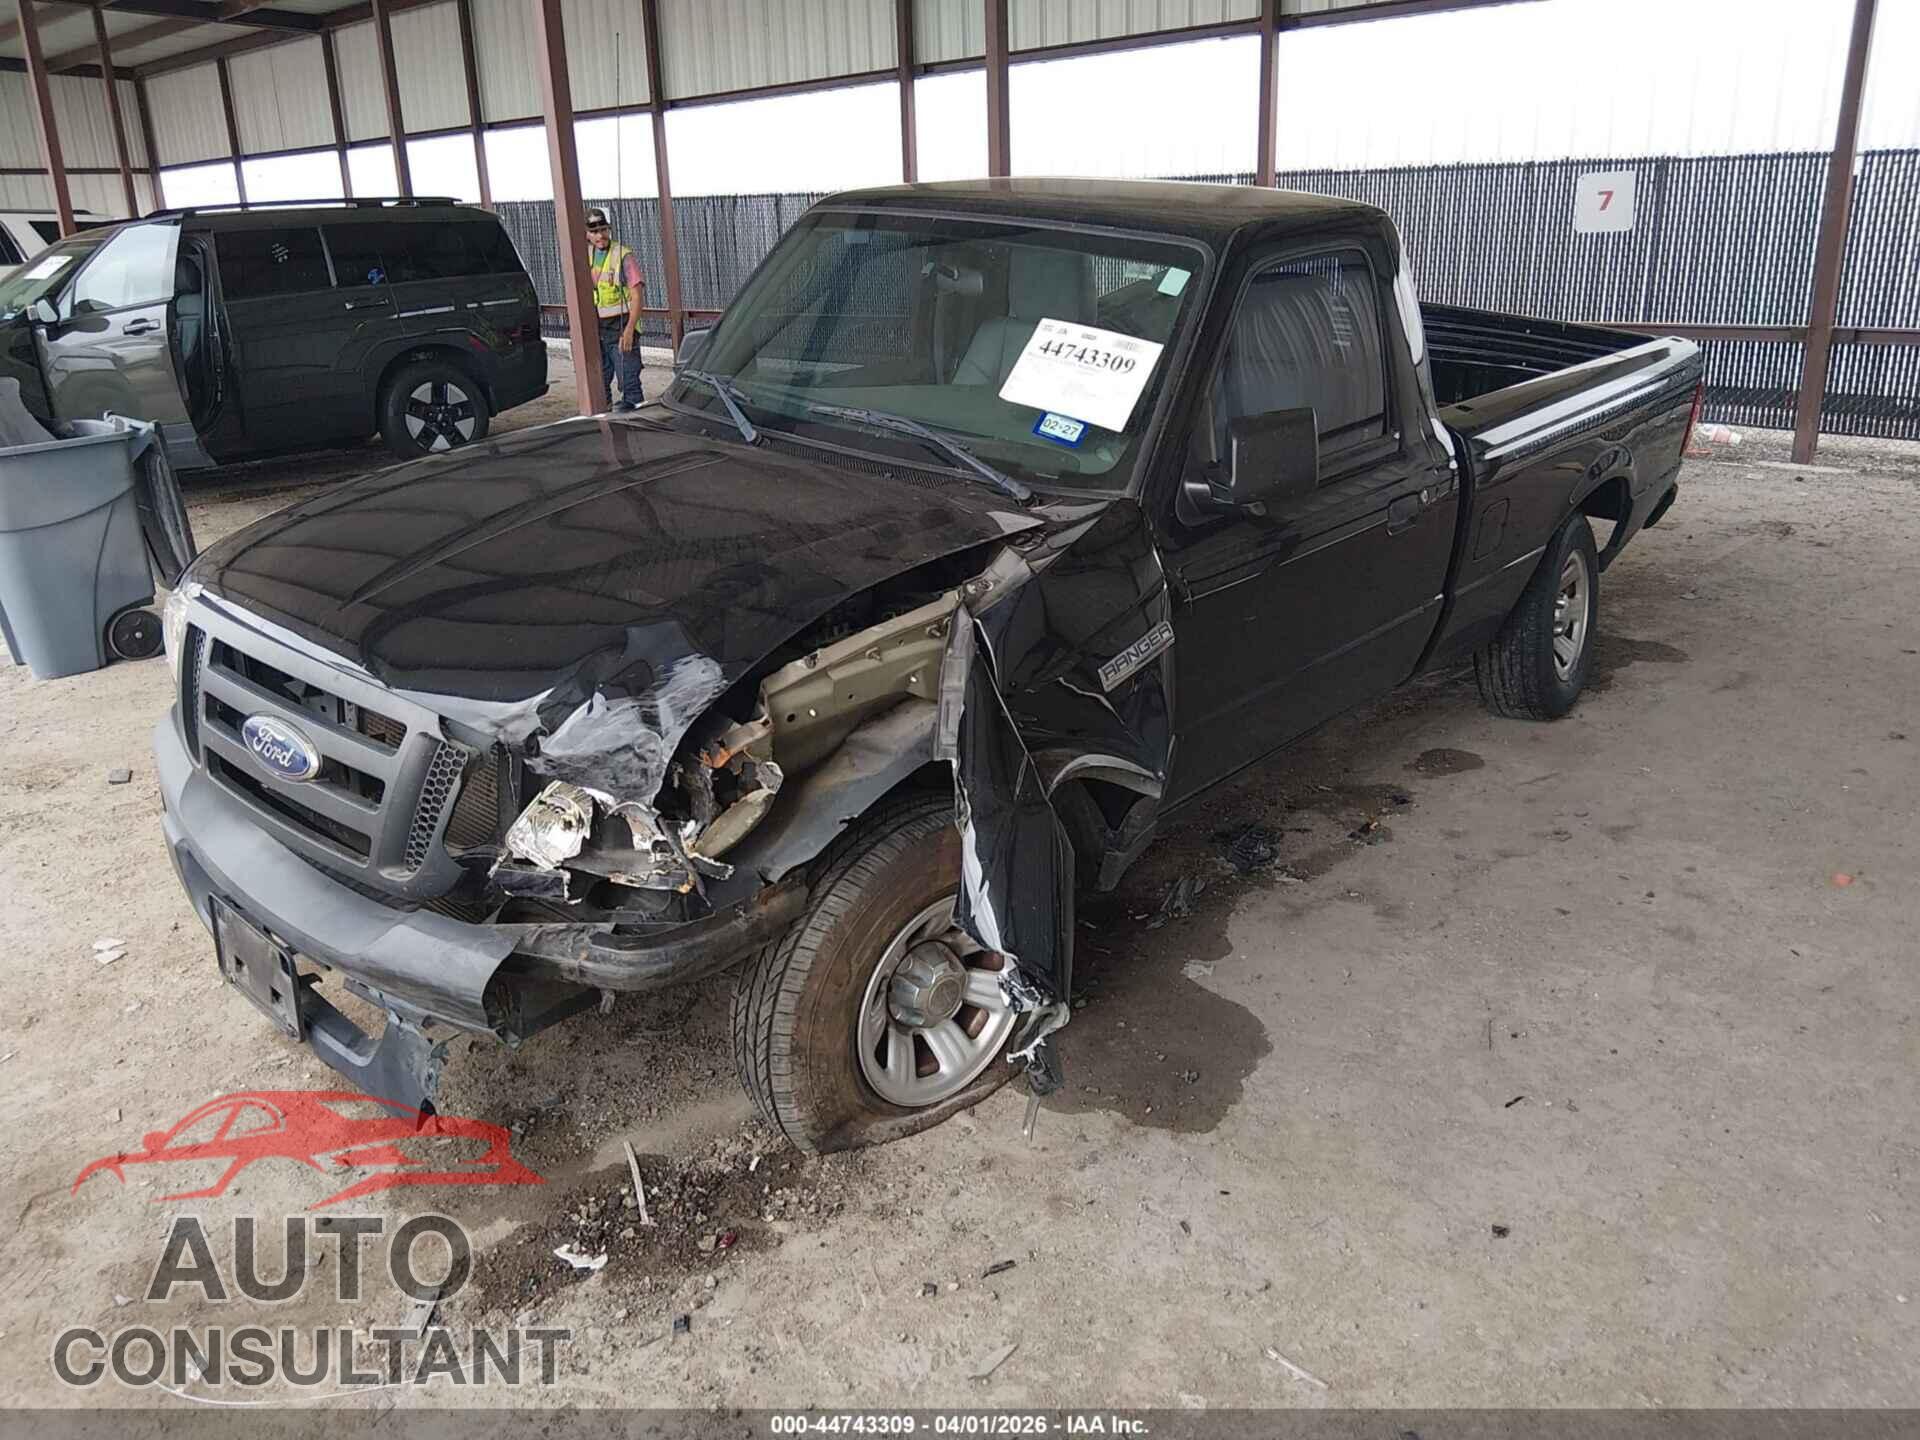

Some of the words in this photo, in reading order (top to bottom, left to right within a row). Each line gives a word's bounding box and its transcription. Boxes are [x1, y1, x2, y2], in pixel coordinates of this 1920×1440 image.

[1597, 190, 1615, 211] 7
[1040, 339, 1137, 374] 44743309
[1101, 623, 1172, 681] RANGER
[252, 725, 294, 767] Ford
